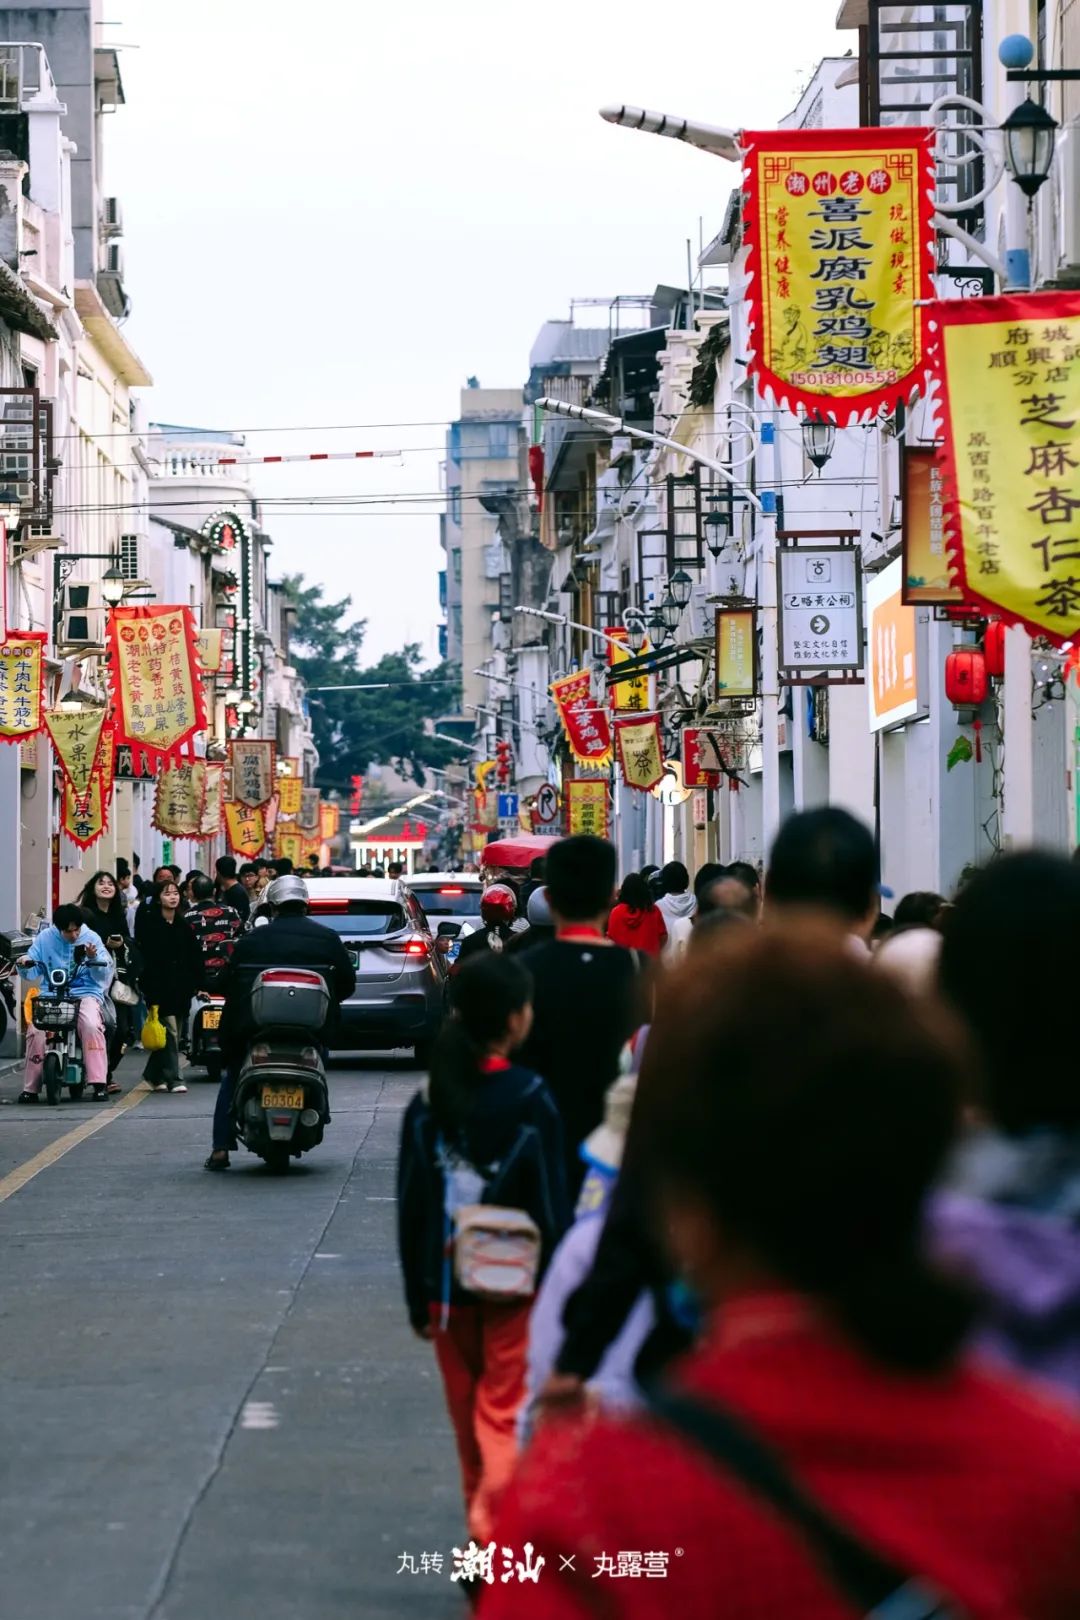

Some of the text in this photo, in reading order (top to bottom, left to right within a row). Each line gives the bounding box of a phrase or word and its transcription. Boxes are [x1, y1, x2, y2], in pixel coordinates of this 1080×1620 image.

[786, 171, 890, 194] 潮州老牌
[774, 207, 792, 299] 营养健康
[889, 203, 908, 295] 现做现卖
[807, 198, 874, 369] 喜派腐乳鸡翅
[1005, 325, 1072, 345] 府城
[790, 370, 897, 386] 15018100558
[1012, 367, 1071, 386] 分店
[1020, 393, 1080, 617] 芝麻杏仁茶
[14, 661, 32, 693] 牛肉丸
[13, 696, 31, 728] 牛筋丸
[67, 724, 90, 783] 水果汁
